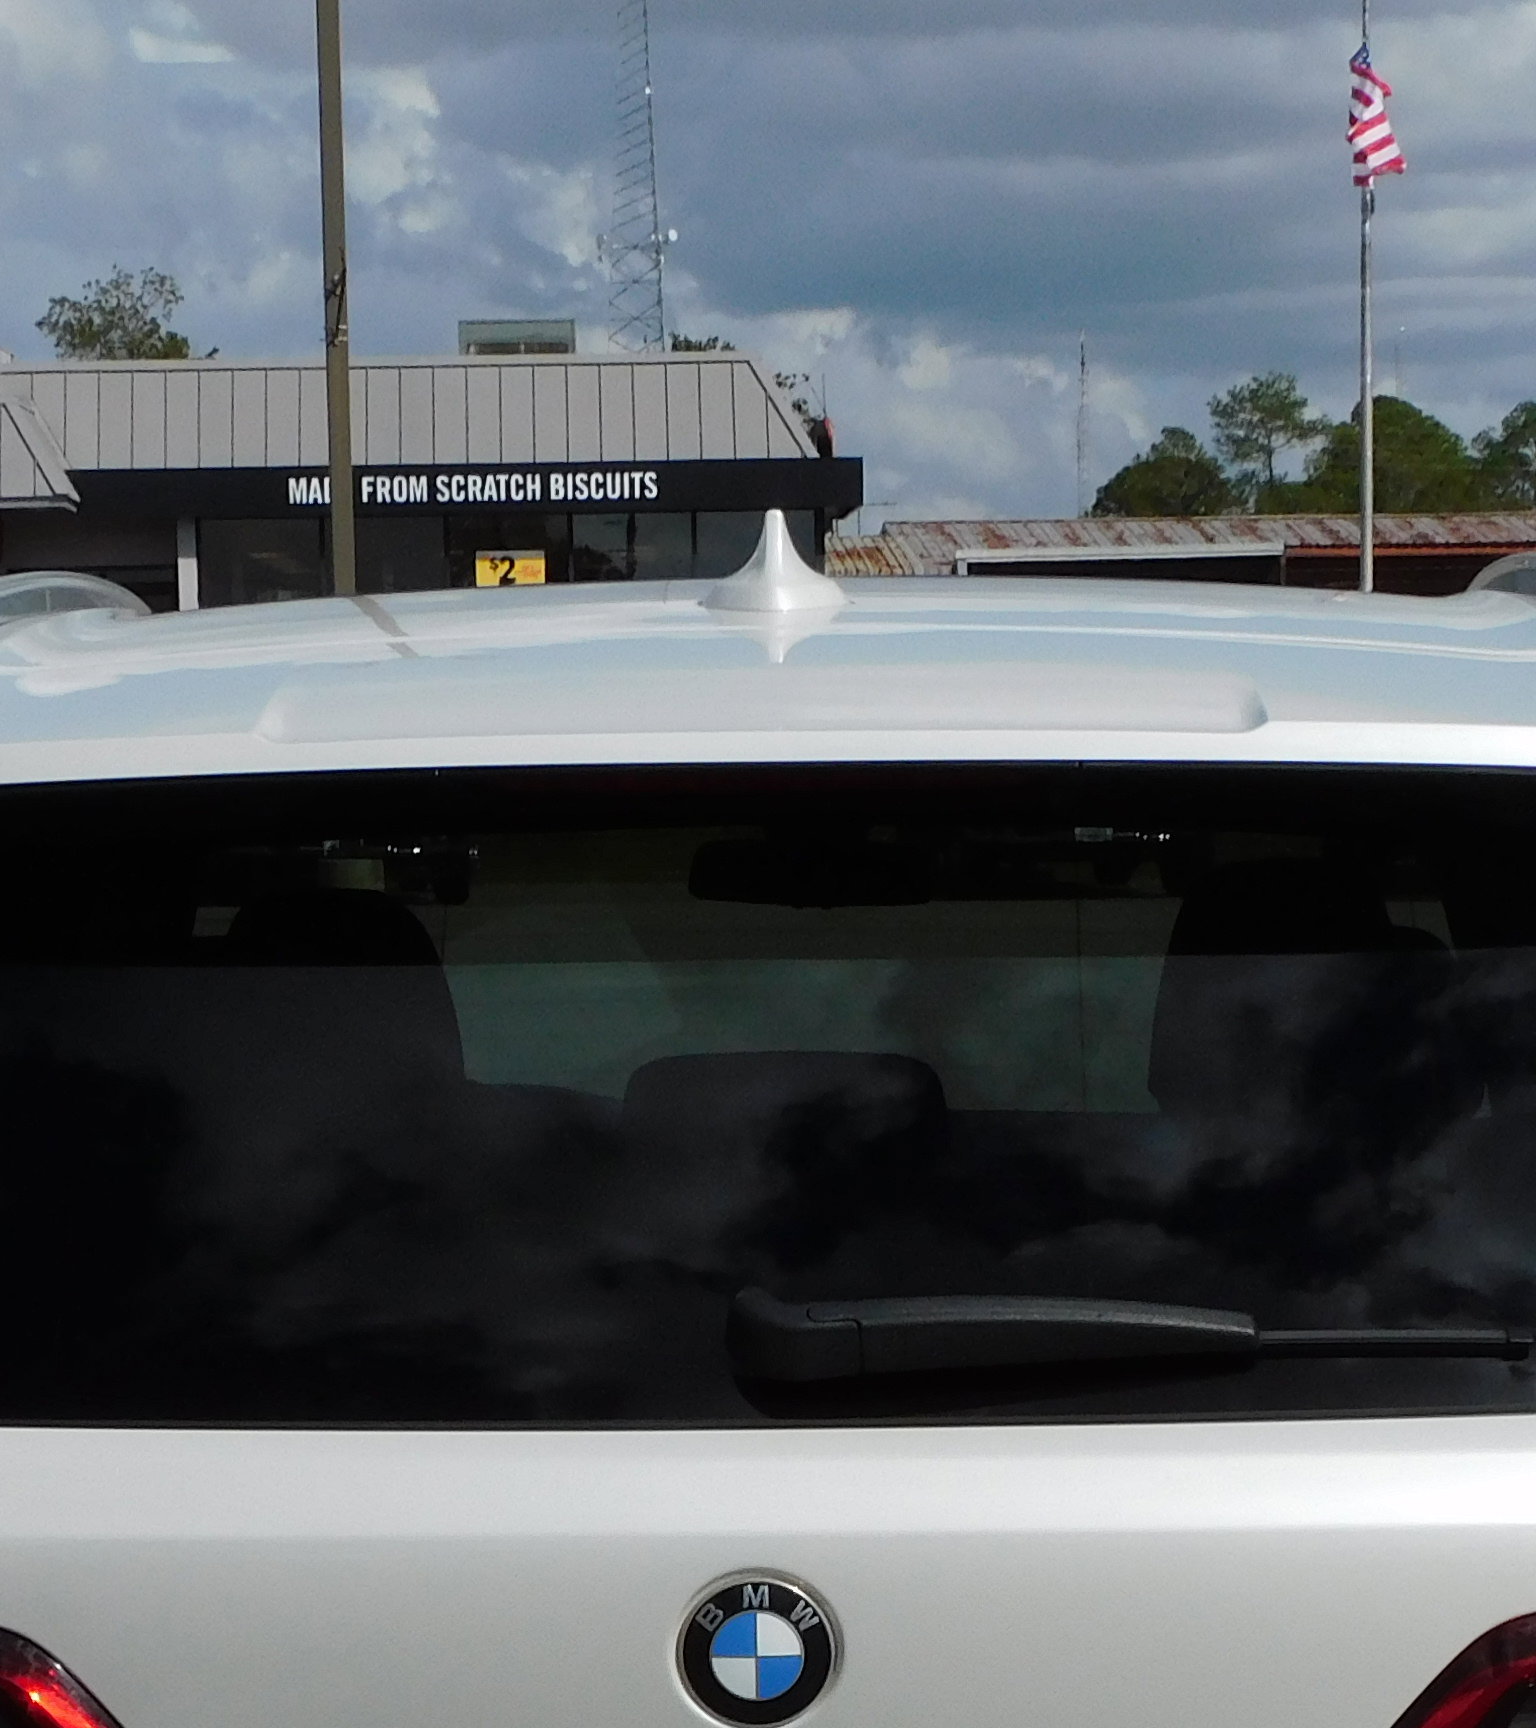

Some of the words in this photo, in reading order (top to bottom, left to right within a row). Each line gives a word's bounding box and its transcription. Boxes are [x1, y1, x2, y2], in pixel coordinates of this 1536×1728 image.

[288, 476, 331, 504] MA
[361, 475, 428, 503] FROM
[435, 473, 541, 502] SCRATCH
[549, 471, 658, 500] BISCUITS
[695, 1584, 820, 1632] BMW
